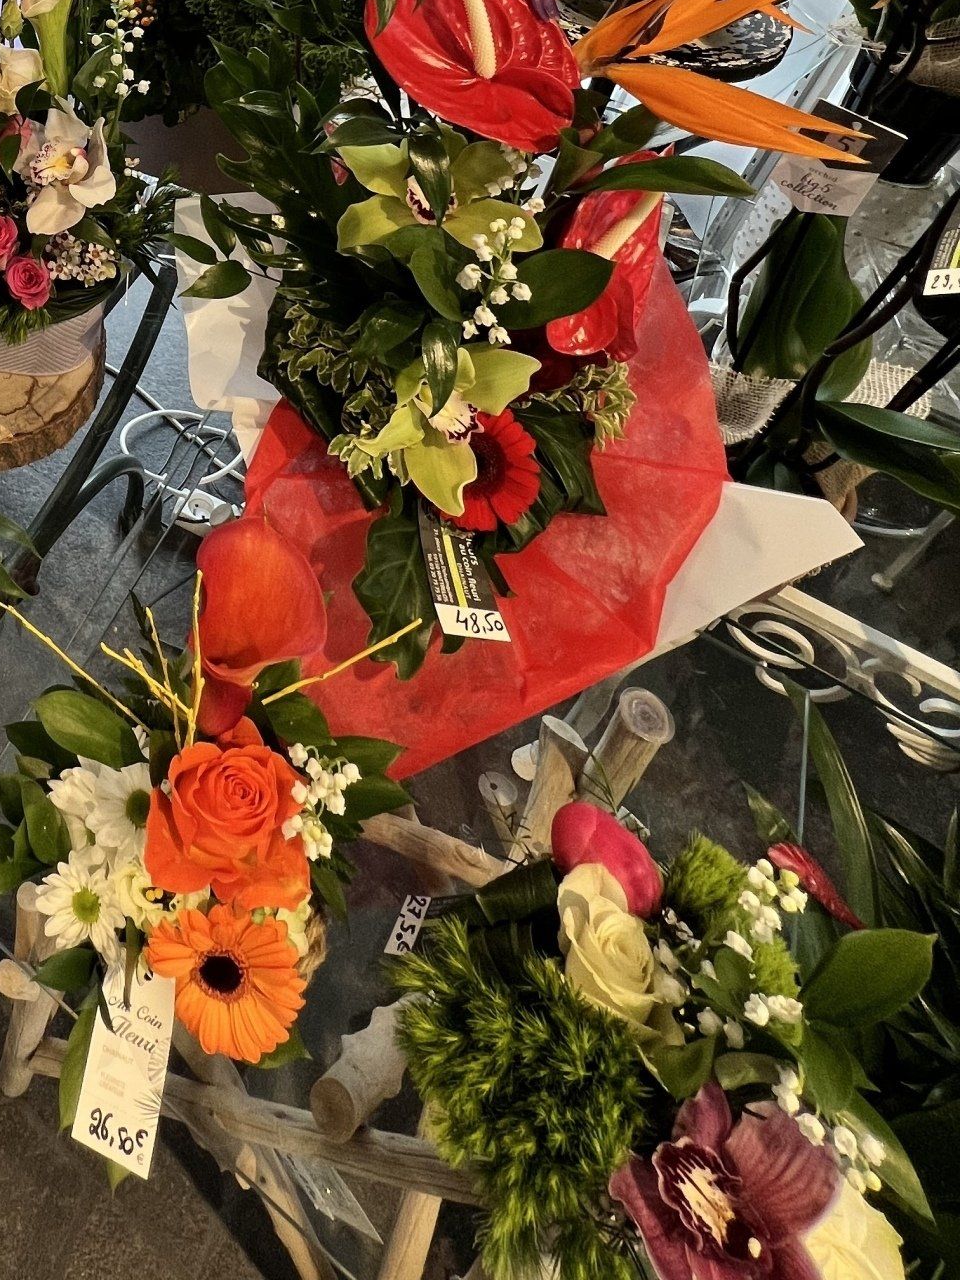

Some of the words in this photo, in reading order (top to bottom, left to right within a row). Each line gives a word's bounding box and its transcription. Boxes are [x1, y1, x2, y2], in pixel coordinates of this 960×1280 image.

[838, 136, 856, 151] 5
[809, 167, 838, 181] orchid
[781, 179, 838, 211] collection
[821, 183, 833, 193] 5
[458, 543, 467, 556] au
[462, 556, 473, 576] coin
[468, 576, 481, 602] fleuri
[456, 610, 503, 634] 48,50
[137, 1005, 162, 1029] Coin
[111, 1015, 158, 1053] Fleuri
[90, 1108, 148, 1155] 26,50€
